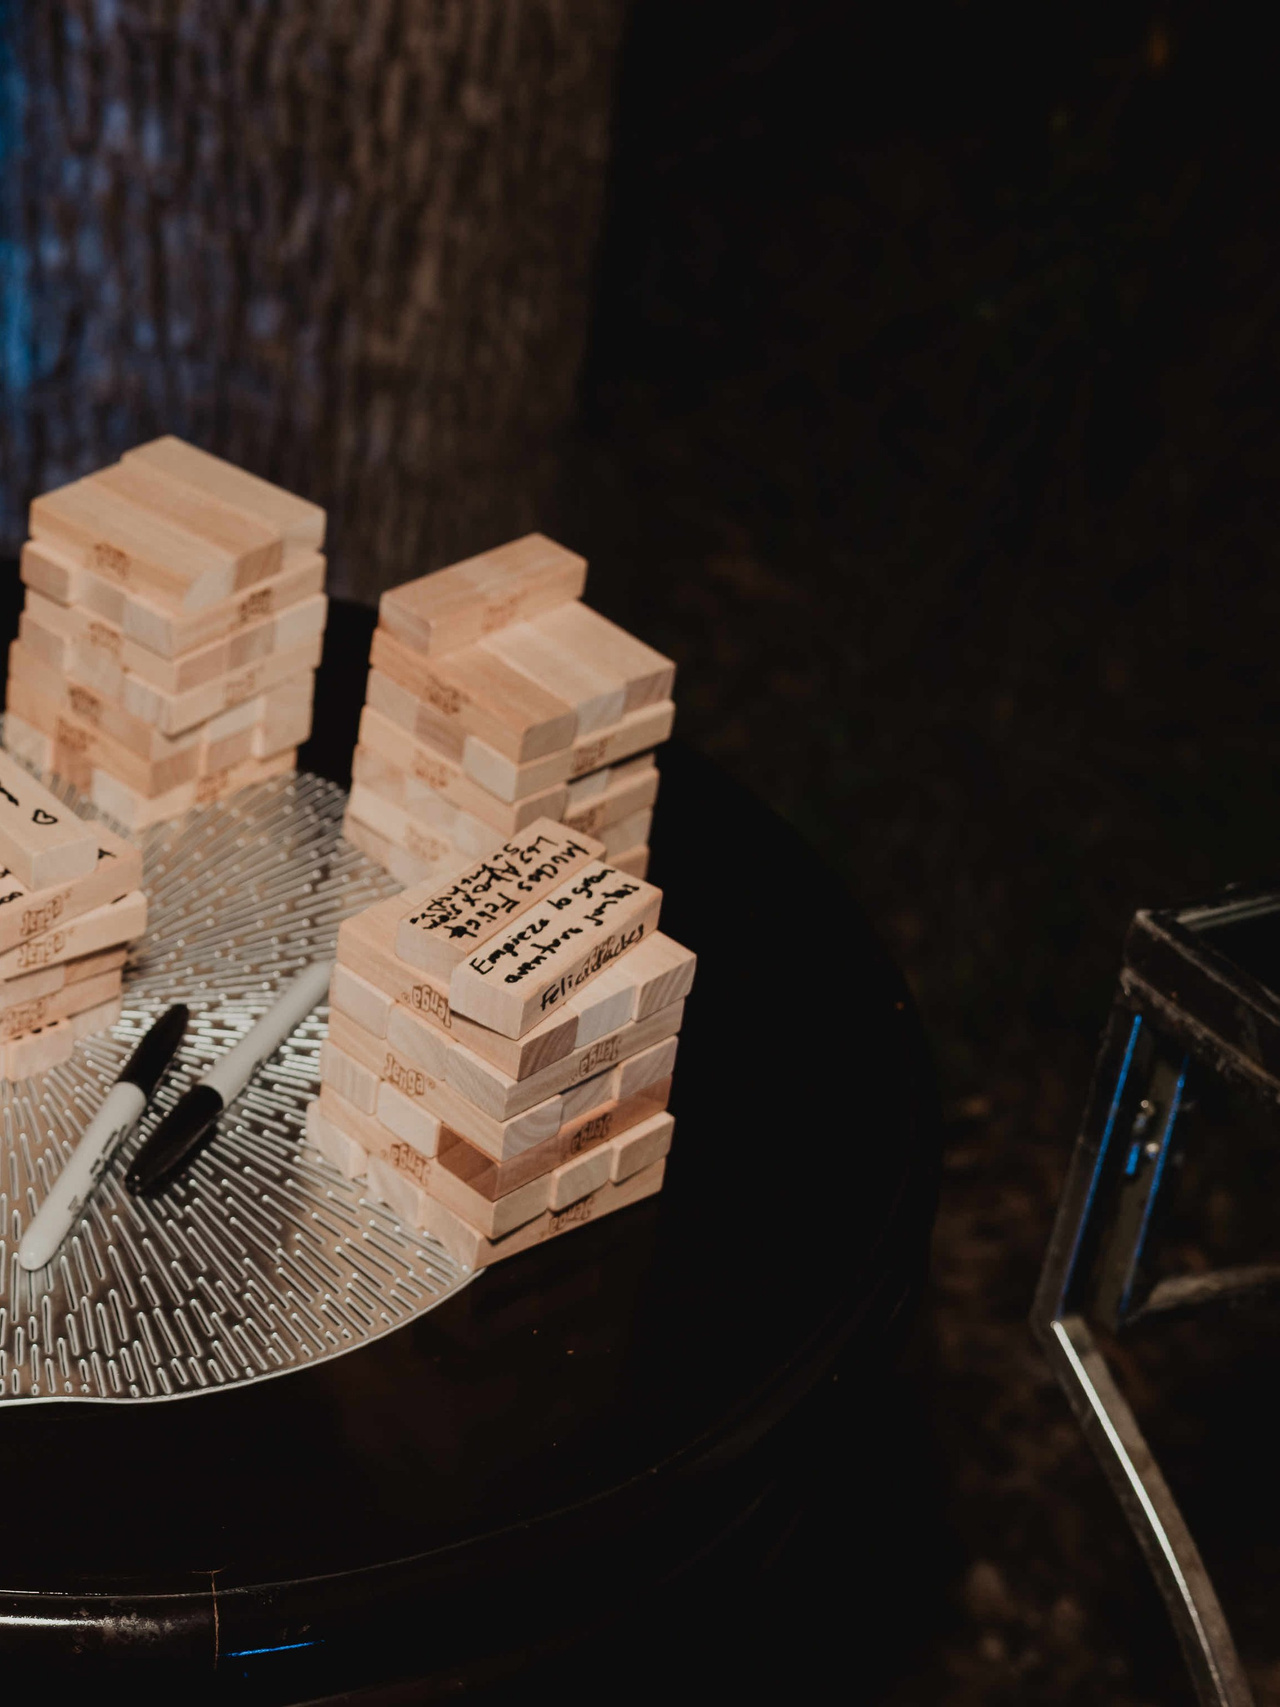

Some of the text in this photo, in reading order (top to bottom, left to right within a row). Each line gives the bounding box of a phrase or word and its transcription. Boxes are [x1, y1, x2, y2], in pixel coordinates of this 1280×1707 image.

[469, 917, 551, 976] Empieza
[411, 984, 452, 1029] Jenga
[384, 1053, 426, 1097] Jenga
[579, 1034, 621, 1073] Jenga
